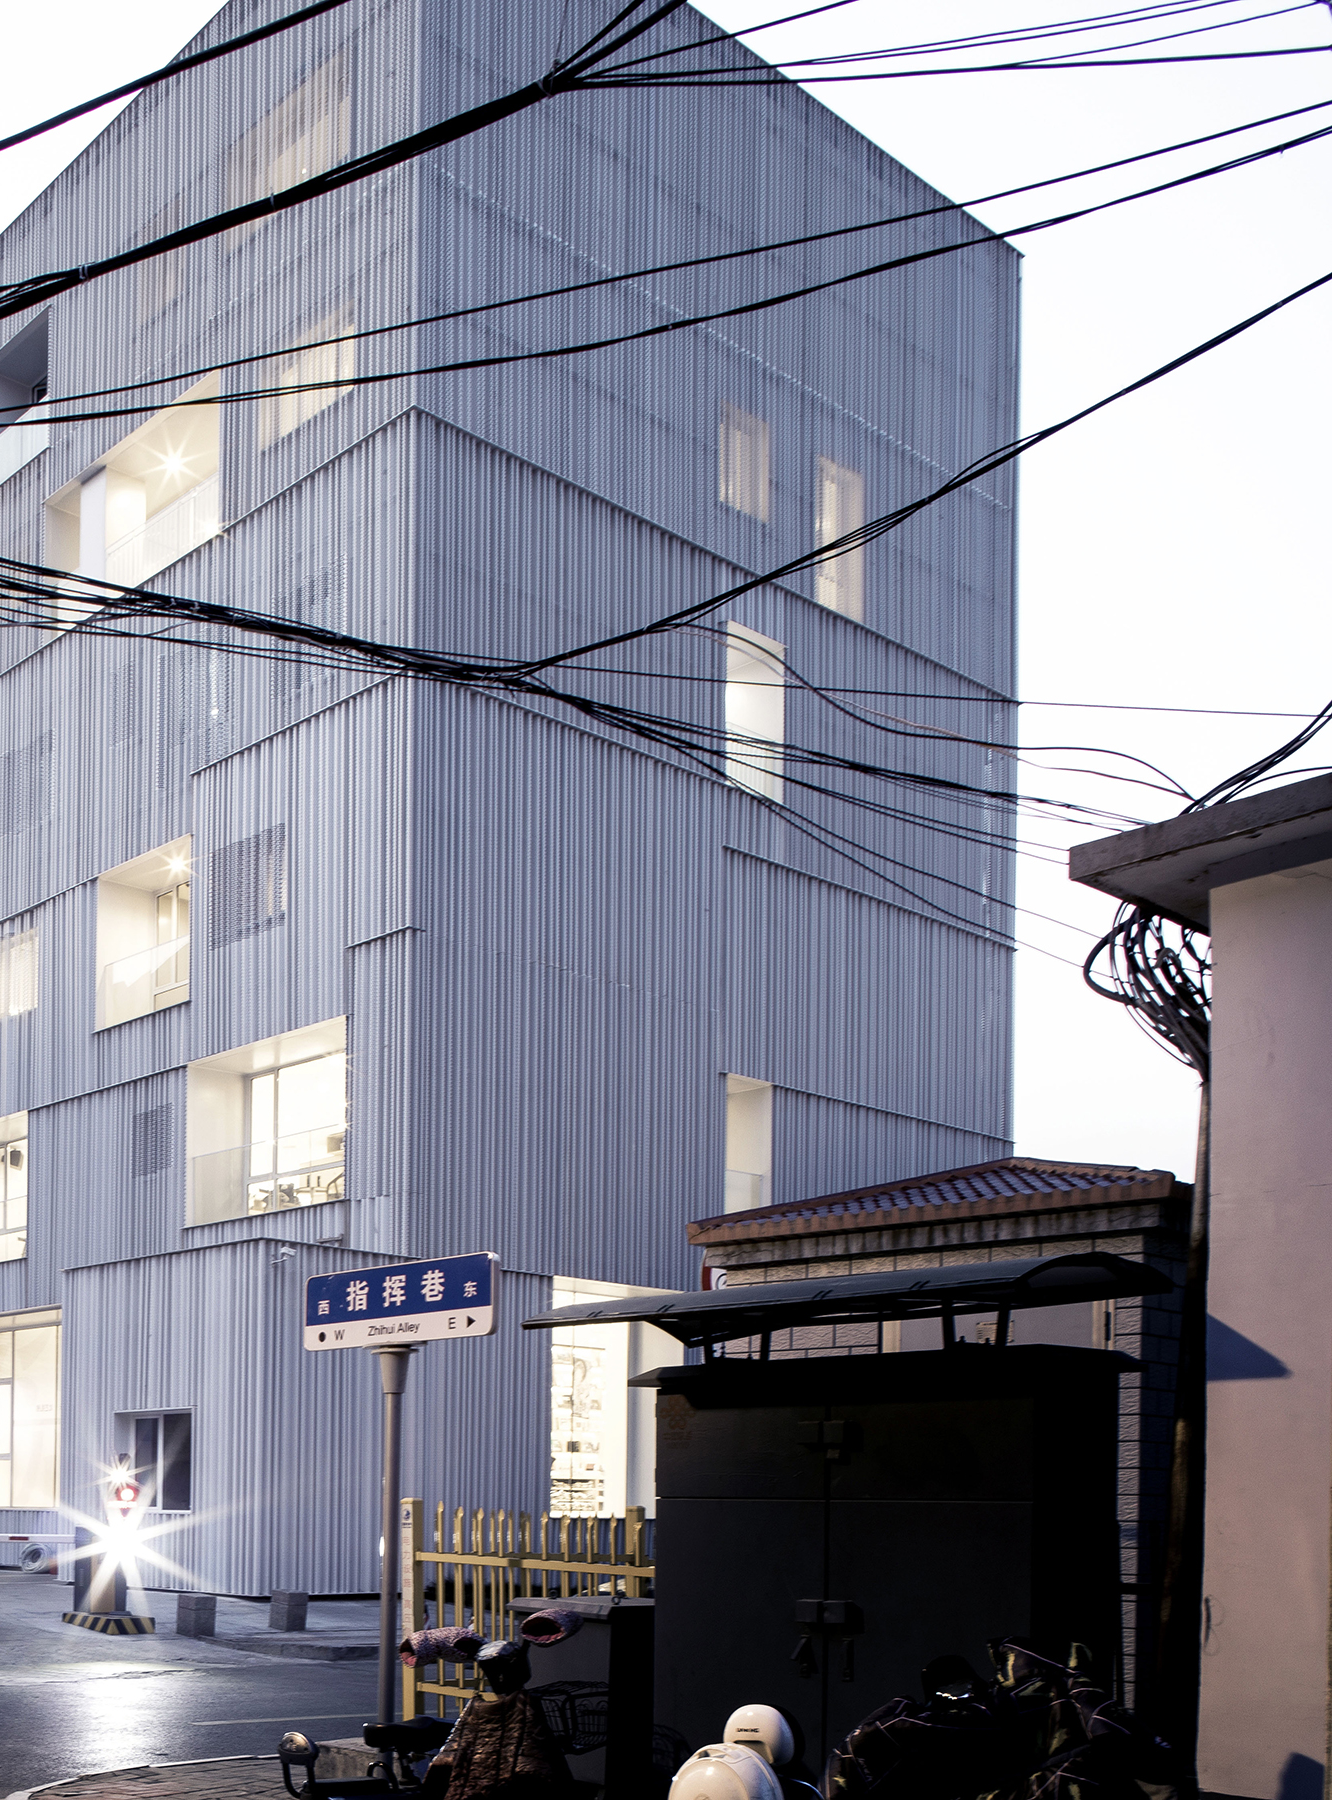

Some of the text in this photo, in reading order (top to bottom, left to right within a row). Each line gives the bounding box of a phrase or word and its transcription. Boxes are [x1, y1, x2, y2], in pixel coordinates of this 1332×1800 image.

[318, 1269, 477, 1315] 西 指挥巷 东
[334, 1317, 456, 1341] W Zhihui Alley E
